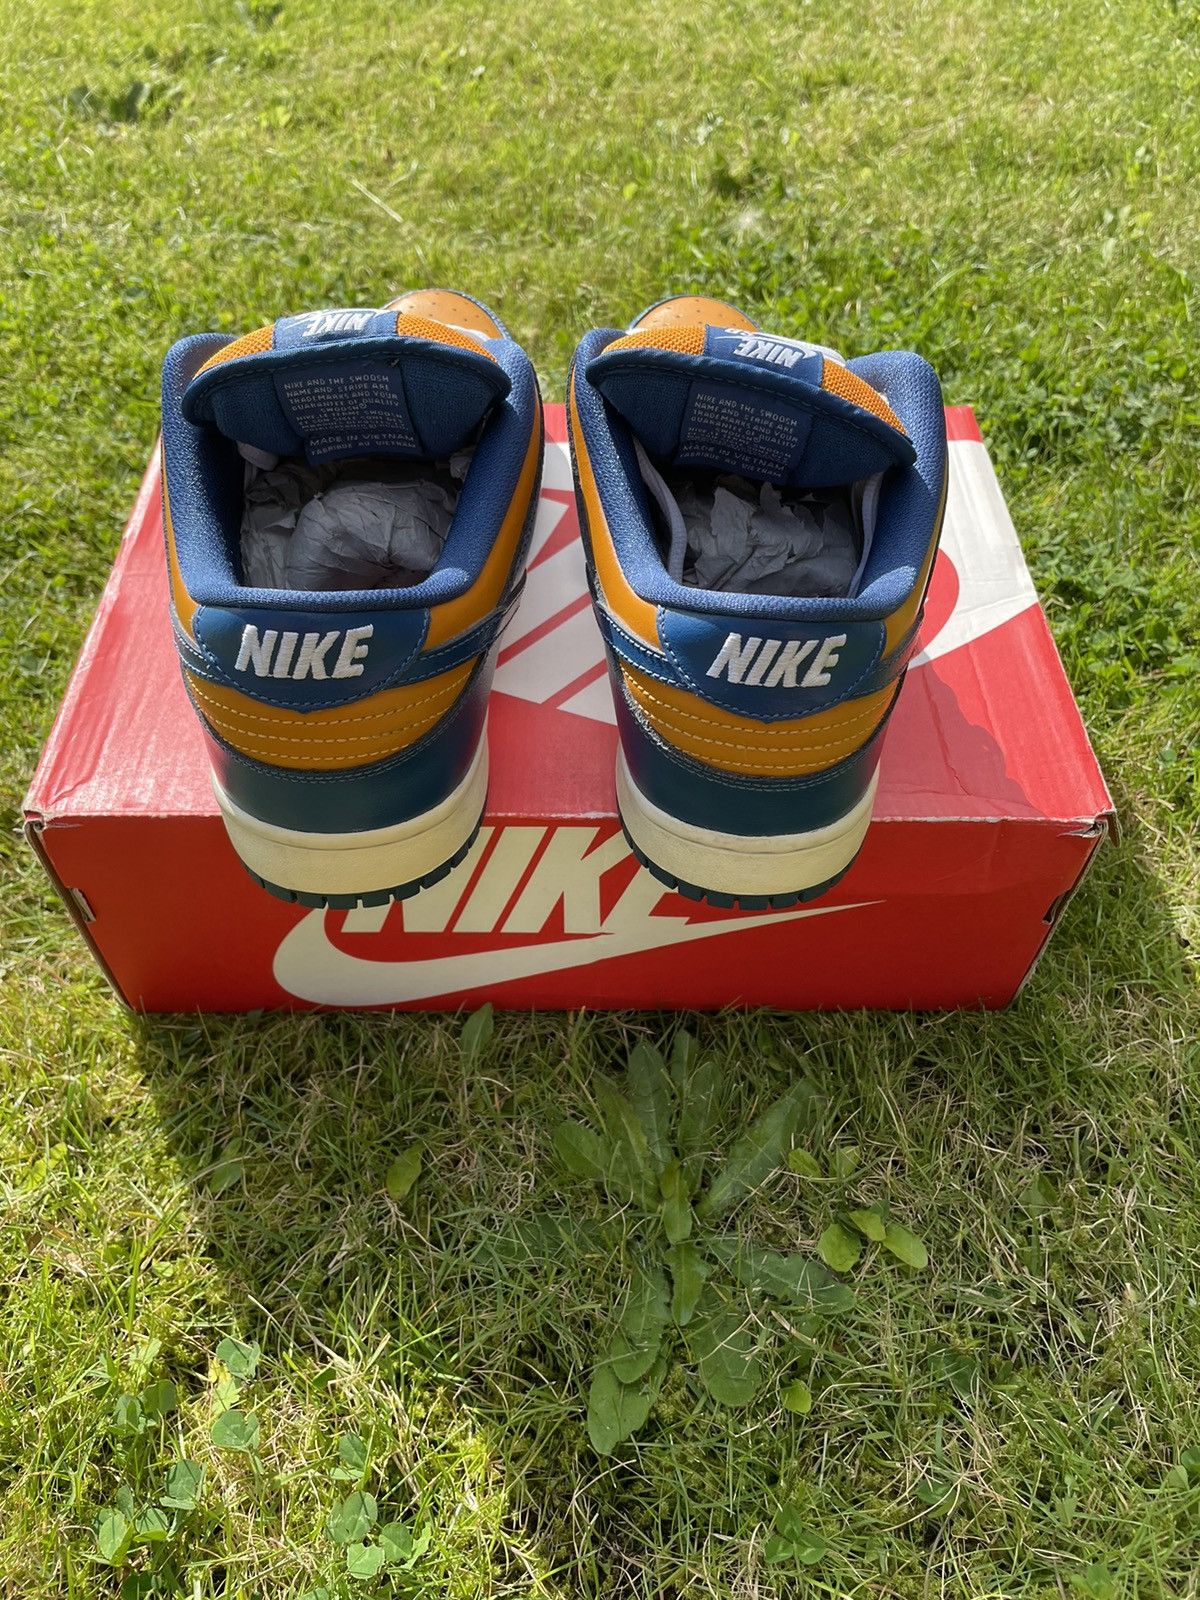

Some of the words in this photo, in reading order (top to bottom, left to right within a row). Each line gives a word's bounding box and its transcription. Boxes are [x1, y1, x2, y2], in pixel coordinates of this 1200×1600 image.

[302, 312, 373, 337] NIKE
[733, 337, 803, 368] NIKE
[284, 381, 304, 391] NIKE
[307, 378, 326, 387] AND
[329, 377, 345, 385] THE
[349, 374, 389, 383] SWOOSH
[286, 388, 311, 398] NAME
[314, 386, 333, 394] AND
[338, 383, 368, 393] STRIPE
[372, 383, 390, 392] ARE
[289, 392, 350, 404] TRADEMARKS
[374, 391, 399, 401] YOUR
[291, 400, 345, 411] GUARANTEE
[362, 398, 400, 407] QUALITY
[696, 393, 716, 404] NIKE
[719, 399, 738, 409] AND
[740, 403, 756, 414] THE
[760, 408, 798, 427] SWOOSH
[693, 409, 751, 430] TRADEMARKS
[753, 425, 771, 435] AND
[774, 431, 799, 443] YOUR
[694, 401, 719, 413] NAME
[721, 408, 740, 417] AND
[744, 414, 774, 429] STRIPE
[776, 424, 794, 434] ARE
[310, 436, 343, 447] MADE
[362, 433, 415, 442] VIETNAM
[375, 440, 417, 449] VIETNAM
[690, 416, 743, 433] GUARANTEE
[759, 433, 797, 449] QUALITY
[683, 445, 715, 453] MADE
[719, 448, 731, 456] IN
[734, 452, 786, 471] VIETNAM
[741, 463, 783, 478] VIETNAM
[234, 624, 374, 680] NIKE
[706, 632, 847, 688] NIKE
